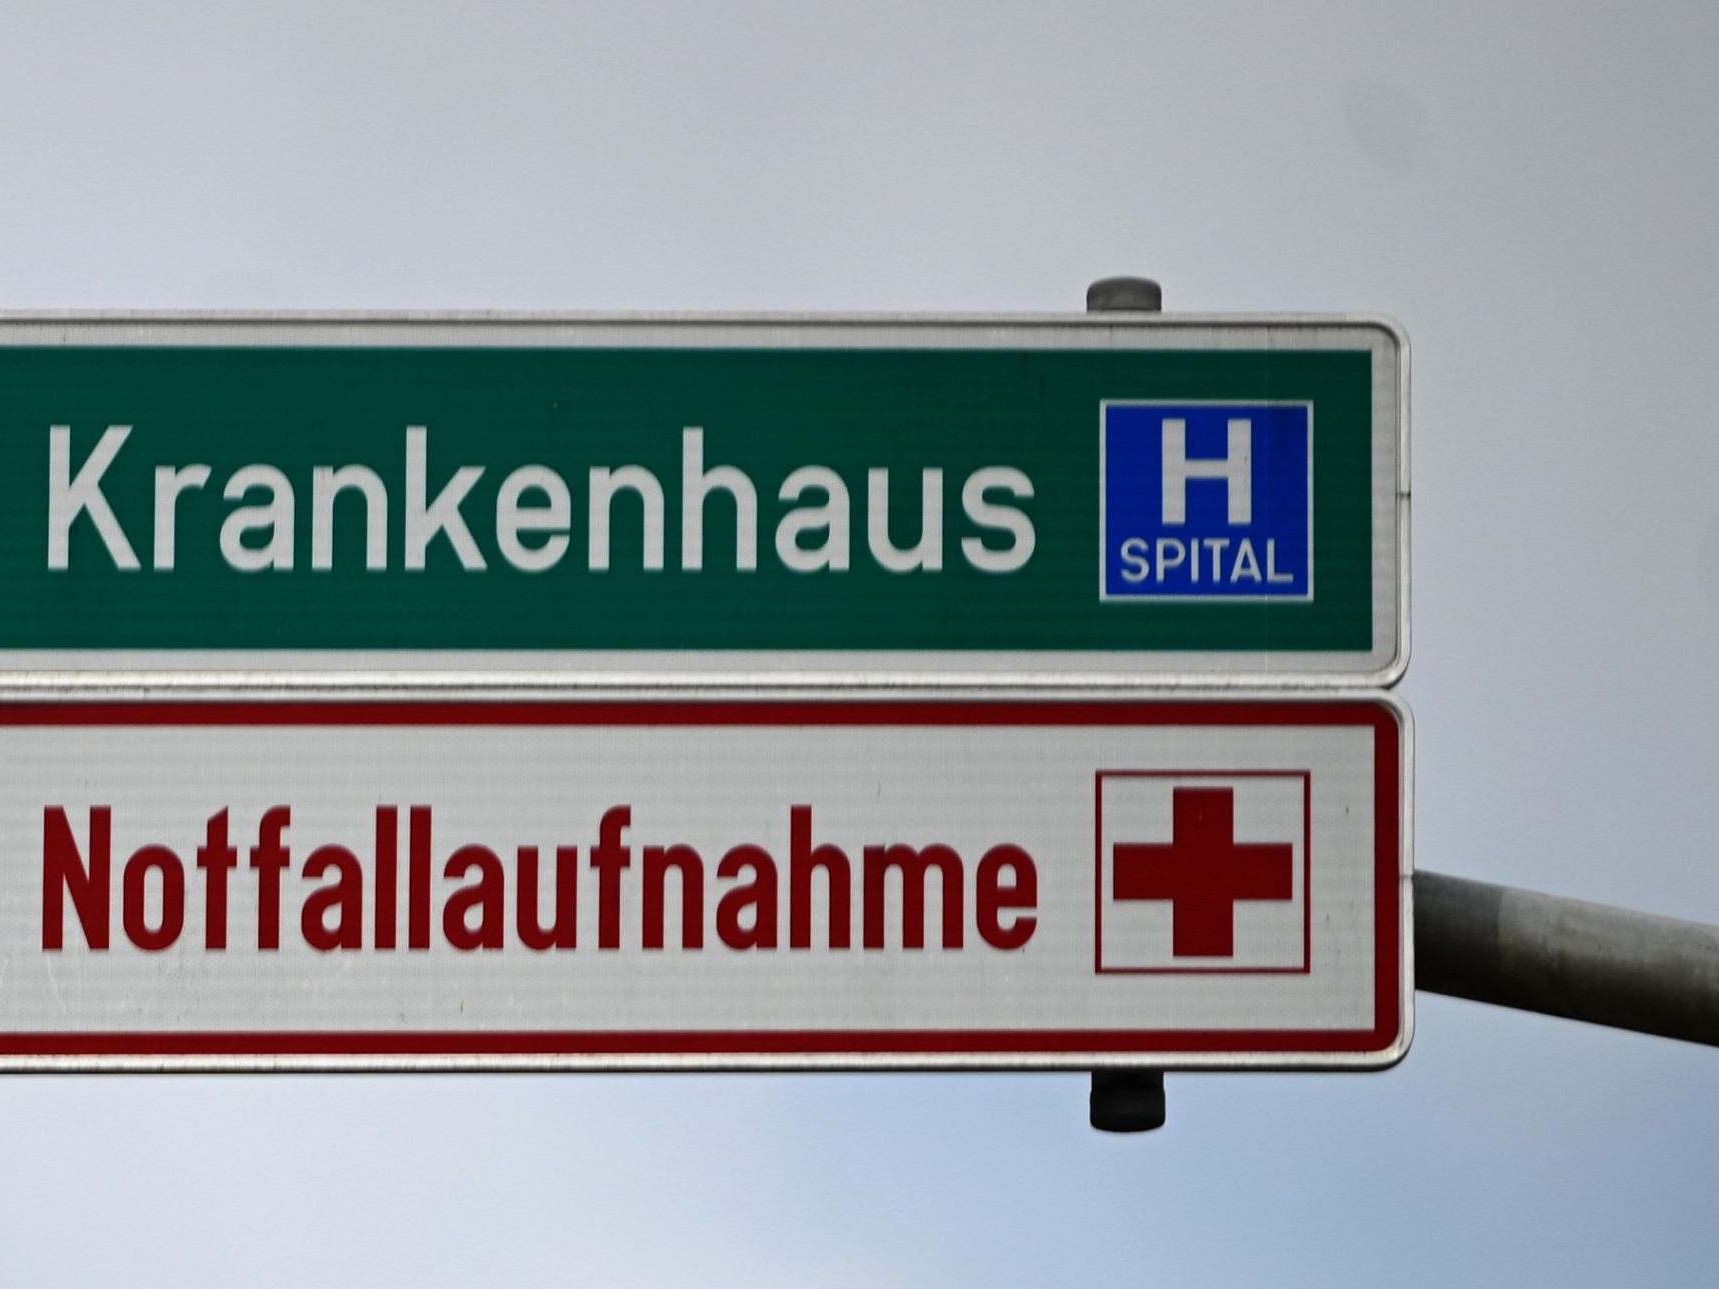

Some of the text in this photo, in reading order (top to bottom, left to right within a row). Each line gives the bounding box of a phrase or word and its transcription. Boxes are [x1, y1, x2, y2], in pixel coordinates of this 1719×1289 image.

[47, 425, 1037, 574] Krankenhaus
[1162, 418, 1252, 526] H
[1120, 536, 1294, 585] SPITAL
[41, 804, 1039, 952] Notfallaufnahme
